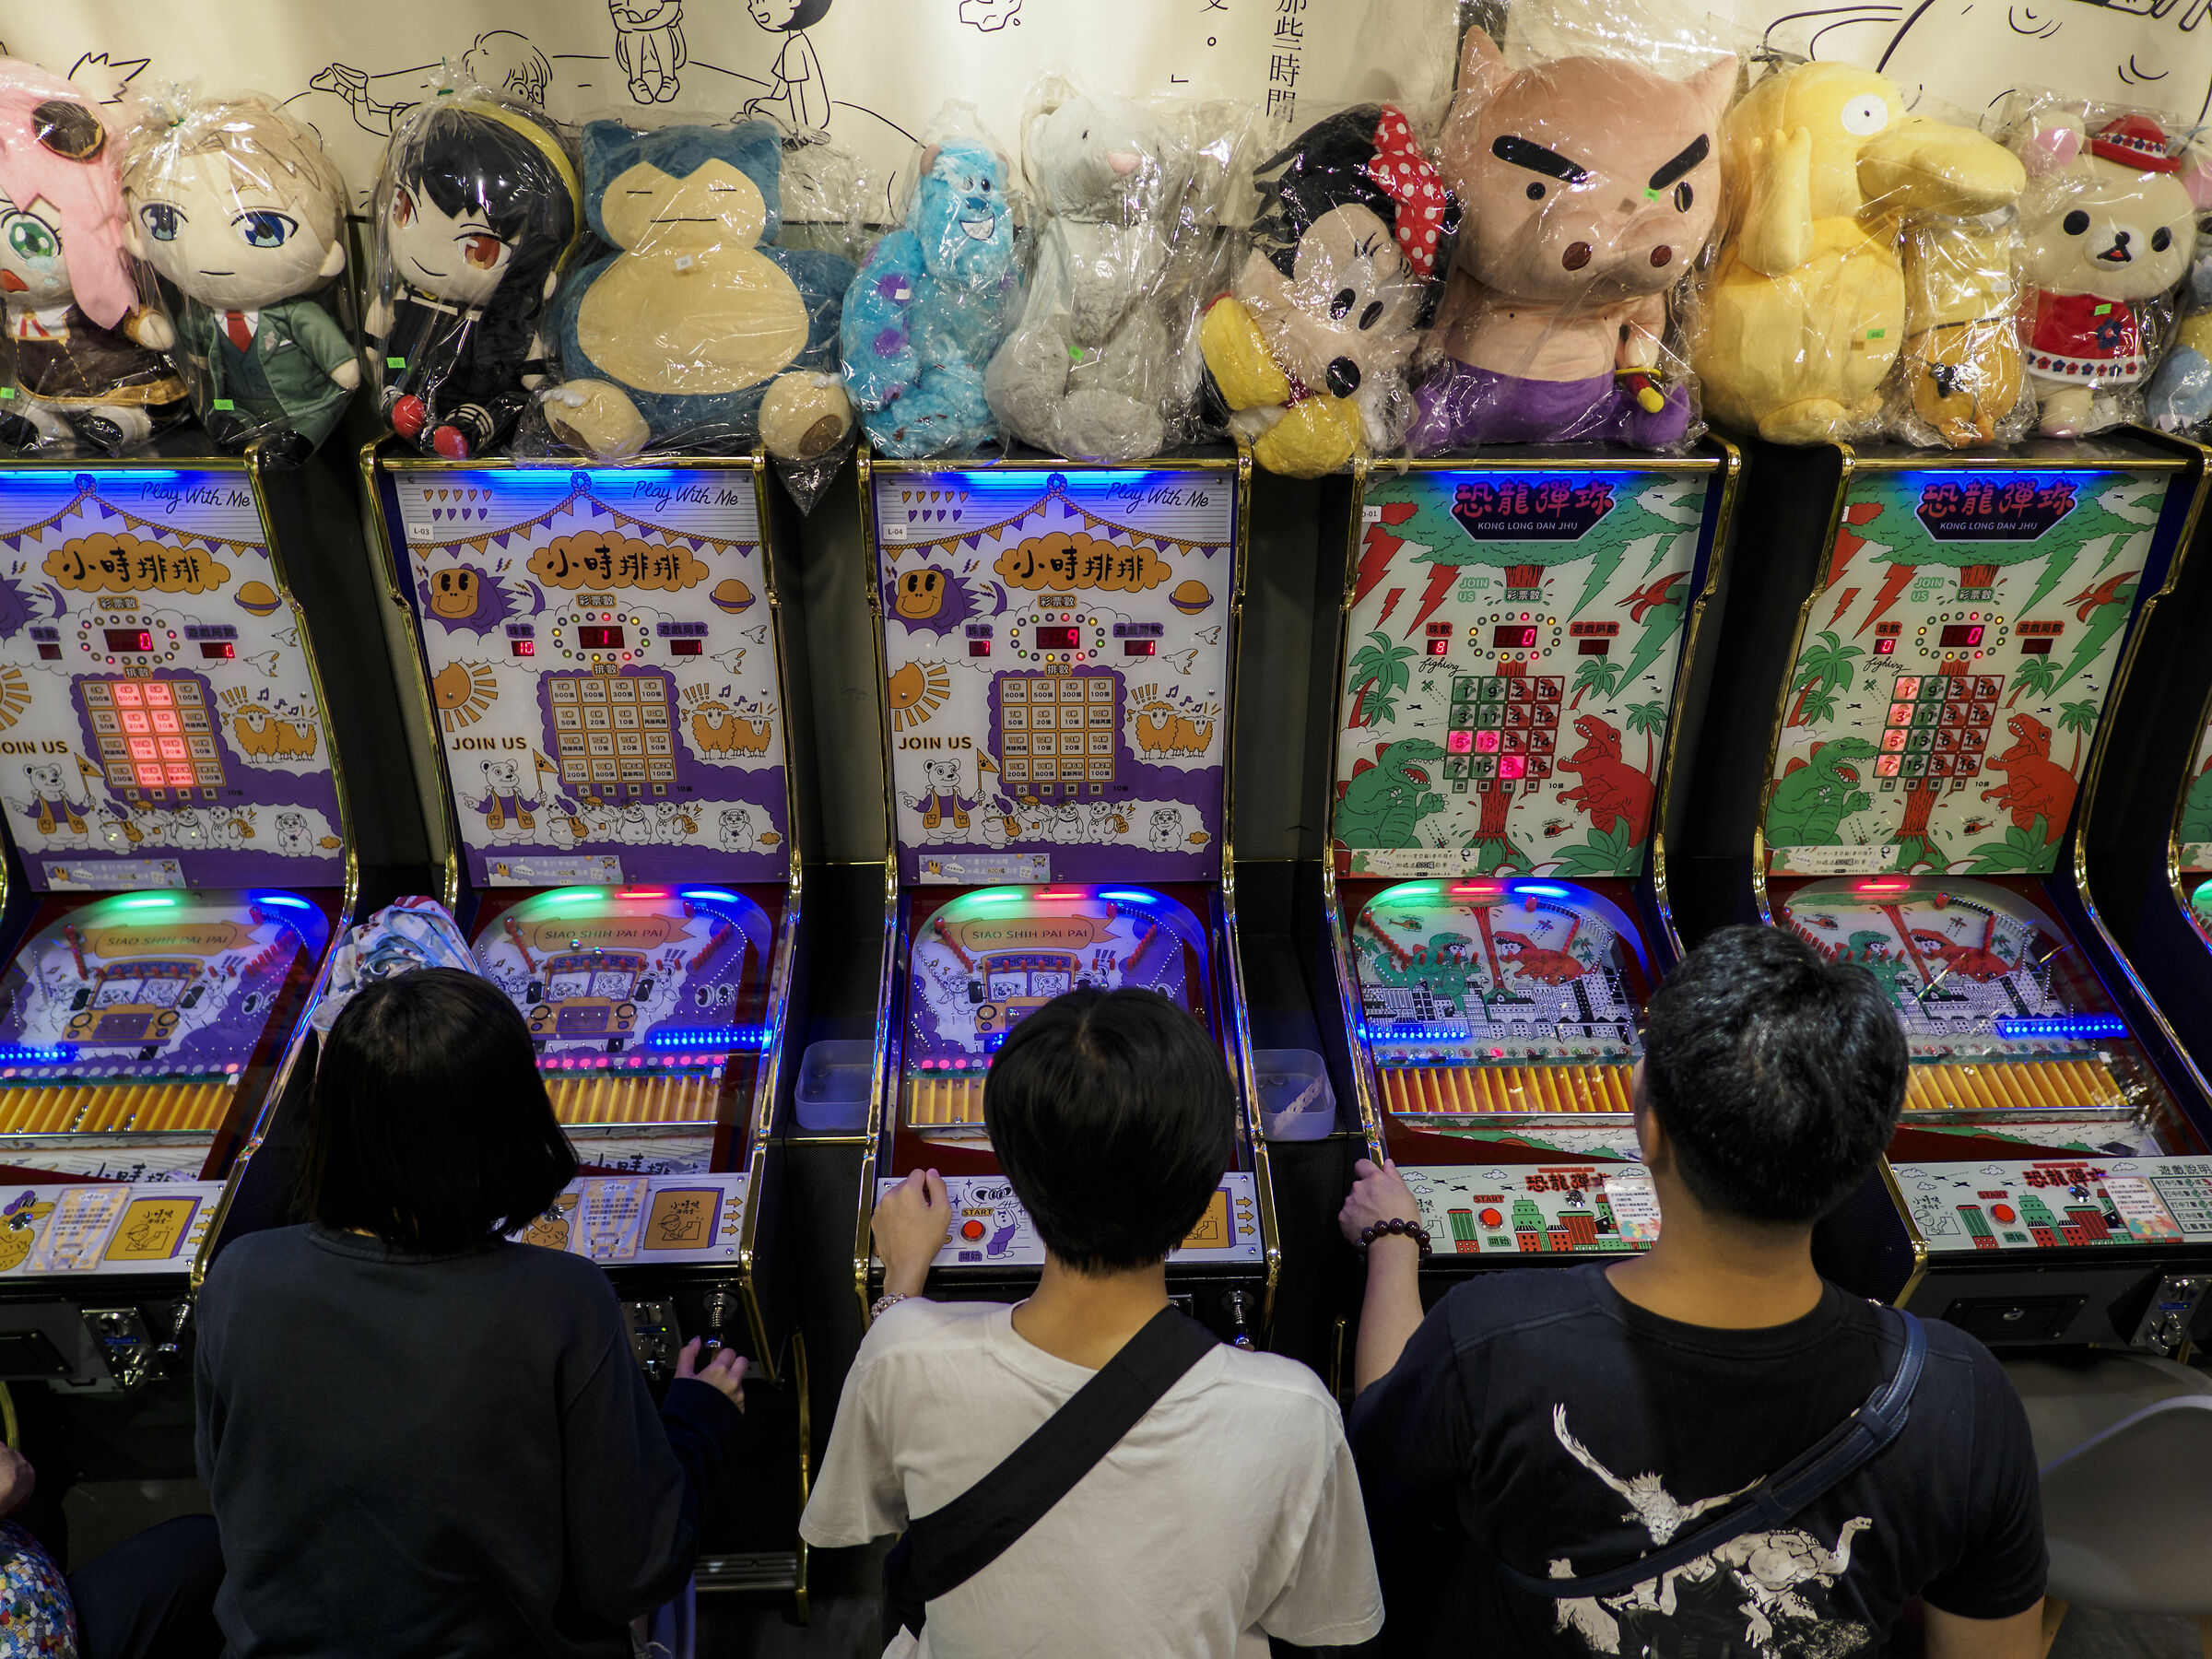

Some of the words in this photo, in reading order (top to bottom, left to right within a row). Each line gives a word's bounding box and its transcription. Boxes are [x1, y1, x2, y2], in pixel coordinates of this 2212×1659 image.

[141, 481, 182, 514] Play
[185, 487, 222, 507] With
[226, 491, 251, 507] Me
[633, 480, 673, 512] Play
[676, 485, 711, 505] With
[714, 488, 738, 505] Me
[1106, 481, 1143, 513] Play
[1147, 487, 1182, 506] With
[1185, 488, 1209, 508] Me
[1456, 479, 1615, 518] 恐龍彈珠
[1918, 481, 2077, 517] 恐龍彈珠
[413, 527, 430, 536] L-03
[1477, 522, 1505, 531] KONG
[1508, 522, 1534, 531] LONG
[1535, 522, 1556, 531] DAN
[1558, 522, 1578, 531] JHU
[1939, 522, 1967, 531] KONG
[1969, 522, 1994, 531] LONG
[1996, 522, 2016, 531] DAN
[2018, 522, 2038, 531] JHU
[888, 528, 903, 536] L-04
[62, 547, 200, 584] 小時排排
[547, 545, 681, 581] 小時排排
[1013, 546, 1144, 582] 小時排排
[1460, 578, 1489, 589] JOIN
[1915, 577, 1944, 589] JOIN
[1459, 591, 1476, 602] US
[1912, 591, 1928, 602] US
[1066, 629, 1078, 645] 9
[1522, 629, 1535, 645] 0
[1967, 628, 1982, 645] 0
[519, 641, 534, 655] 10
[1464, 687, 1467, 697] 1
[1488, 688, 1496, 697] 9
[1516, 687, 1524, 697] 2
[1541, 687, 1557, 697] 10
[1904, 686, 1910, 696] 1
[1928, 687, 1936, 696] 9
[1955, 686, 1963, 696] 2
[1981, 686, 1995, 696] 10
[1459, 714, 1466, 723] 3
[1484, 713, 1497, 723] 11
[1512, 713, 1521, 722] 4
[1537, 712, 1553, 722] 12
[1896, 712, 1903, 722] 3
[1921, 712, 1934, 722] 11
[1948, 712, 1956, 721] 4
[1973, 711, 1989, 721] 12
[452, 737, 499, 751] JOIN
[502, 736, 527, 750] US
[898, 736, 943, 750] JOIN
[947, 736, 972, 750] US
[1456, 738, 1464, 747] 5
[1480, 738, 1494, 747] 13
[1509, 738, 1517, 747] 6
[1535, 737, 1549, 747] 14
[1890, 737, 1898, 747] 5
[1913, 736, 1927, 747] 13
[1942, 736, 1949, 746] 6
[1966, 735, 1981, 745] 14
[0, 741, 37, 754] OIN
[41, 741, 69, 754] US
[1454, 763, 1461, 772] 7
[1477, 762, 1491, 771] 15
[1506, 762, 1513, 771] 8
[1531, 762, 1546, 771] 16
[1885, 762, 1892, 771] 7
[1907, 760, 1921, 771] 15
[1936, 760, 1944, 770] 8
[1960, 760, 1975, 770] 16
[546, 931, 576, 939] SIAO
[580, 930, 612, 938] SHIH
[642, 929, 664, 937] PAI
[972, 931, 1002, 939] SIAO
[1042, 930, 1062, 938] PAI
[1068, 929, 1088, 937] PAI
[107, 937, 139, 946] SIAO
[206, 935, 229, 944] PAI
[963, 1208, 994, 1217] START
